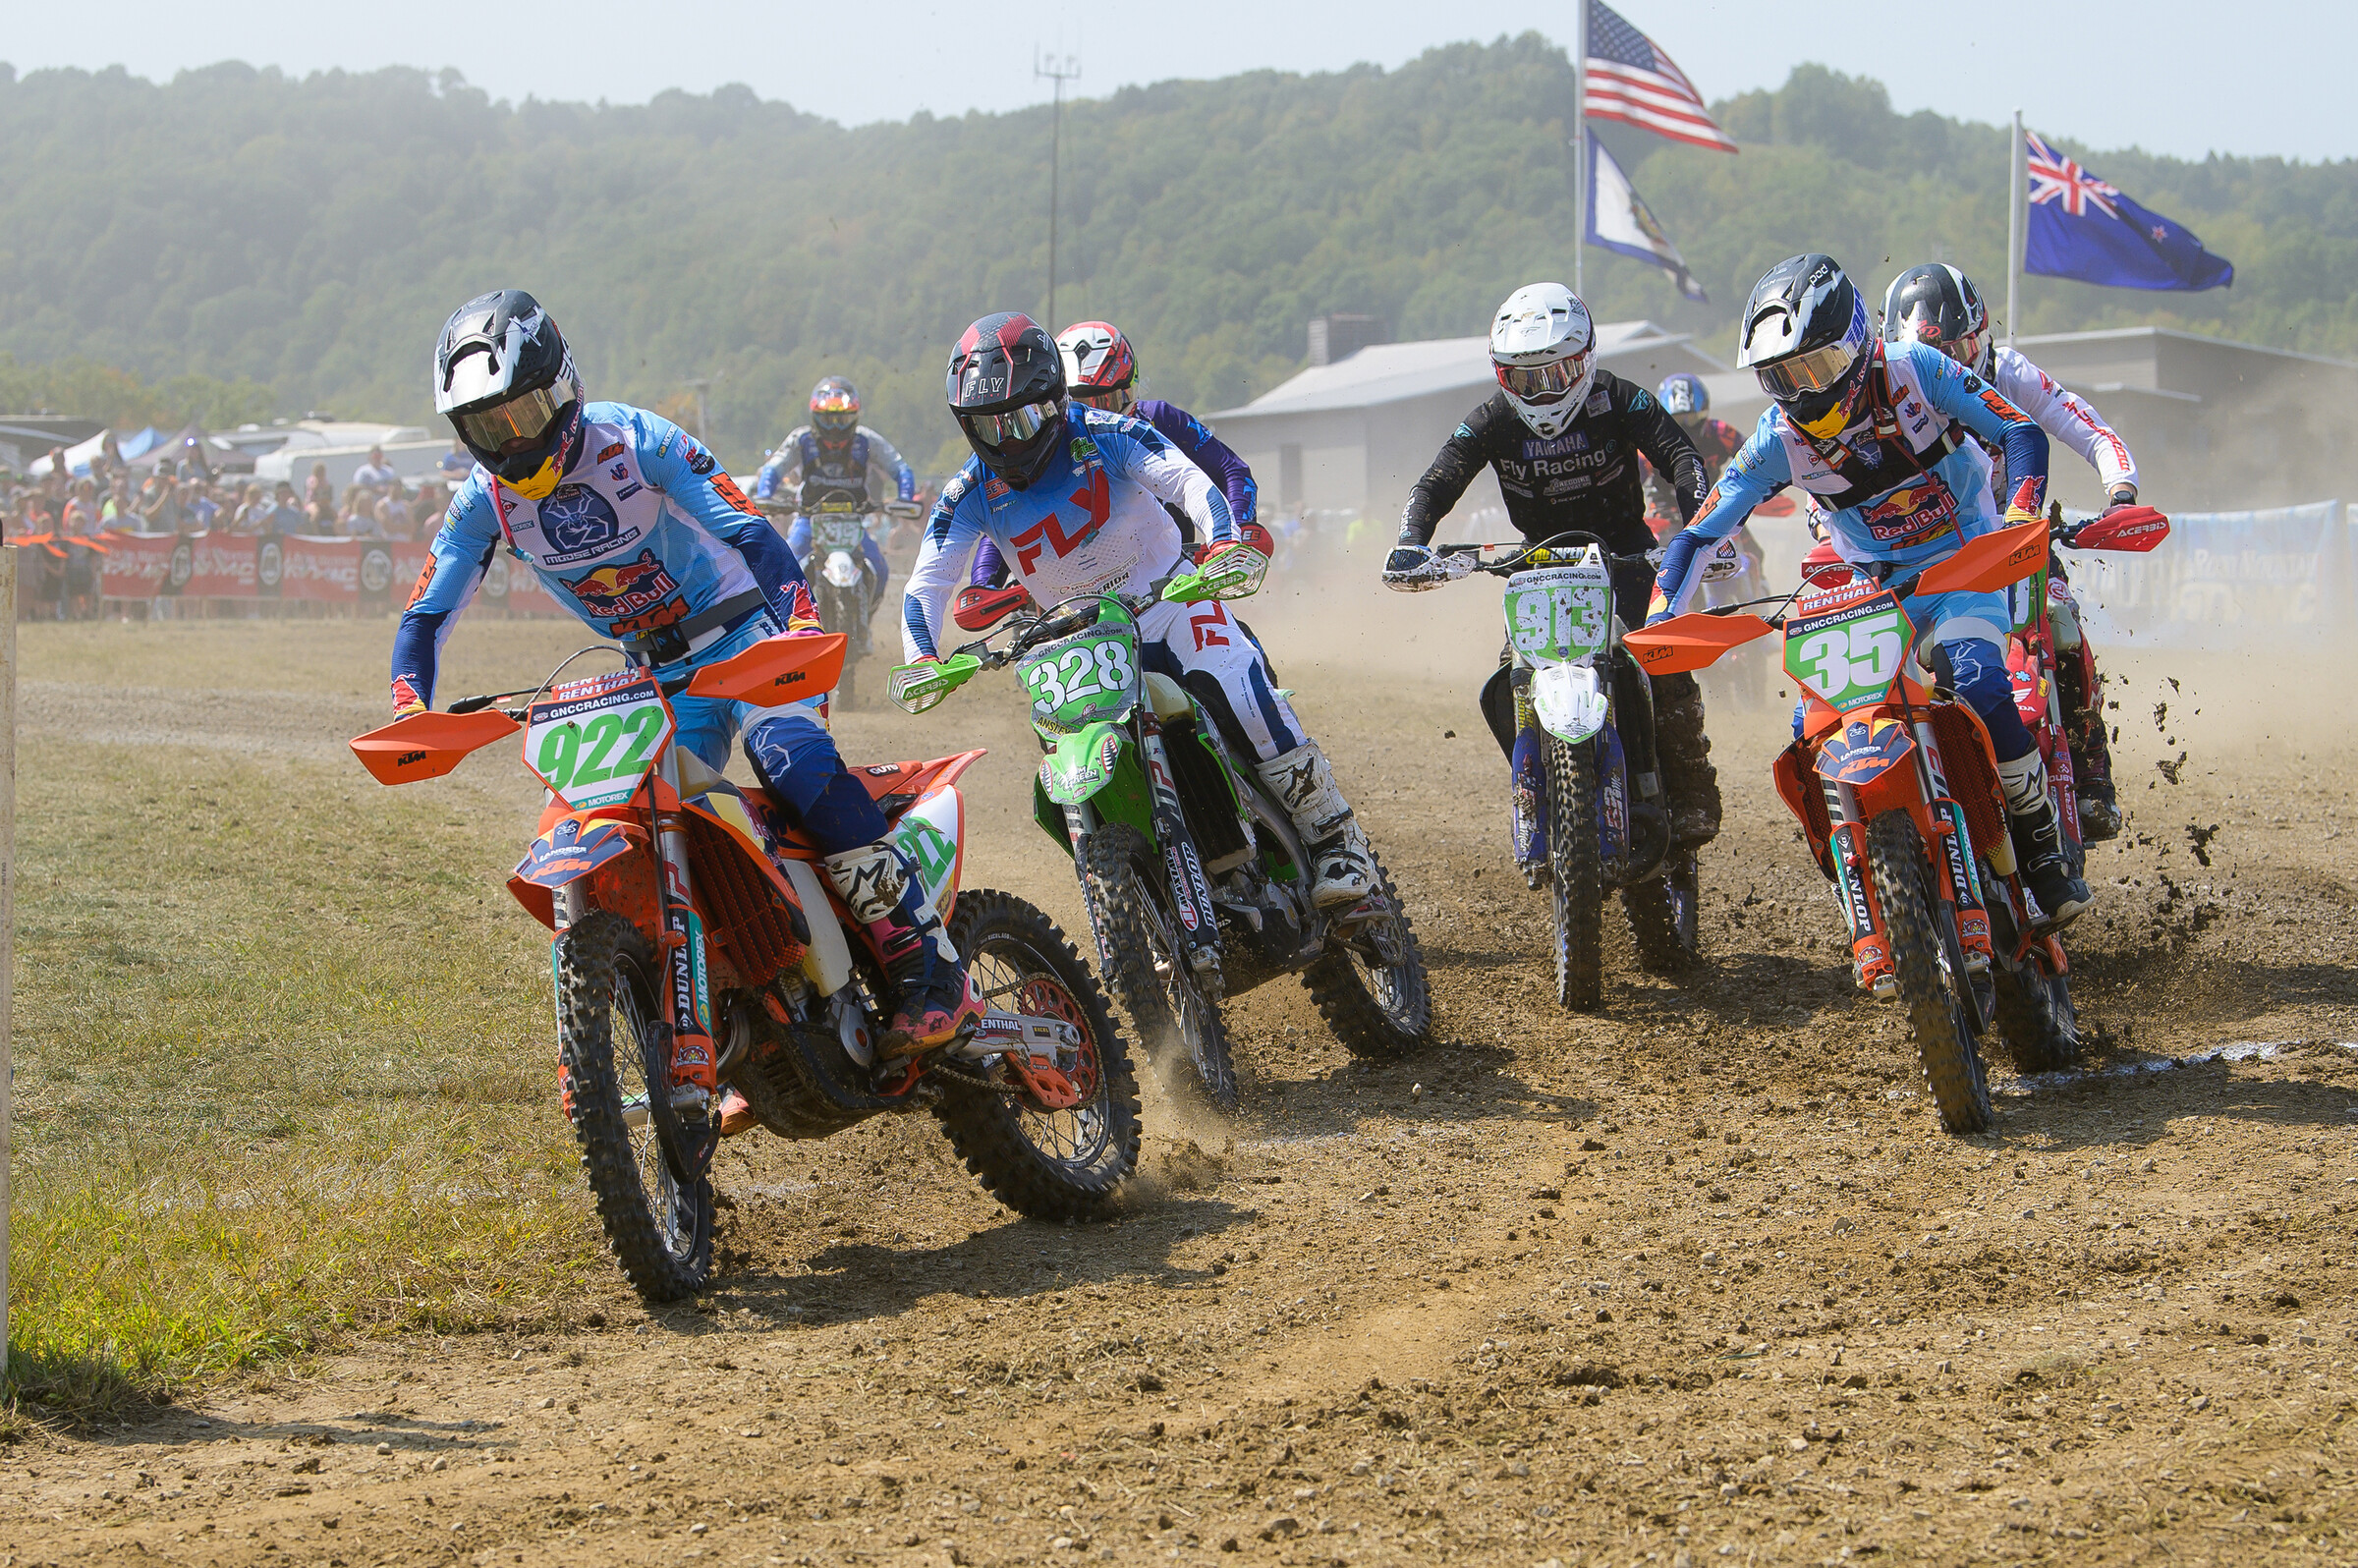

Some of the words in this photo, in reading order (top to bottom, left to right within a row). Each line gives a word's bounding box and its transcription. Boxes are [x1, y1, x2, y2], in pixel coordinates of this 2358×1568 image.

[965, 377, 1004, 398] FLY
[597, 442, 625, 465] KTM
[1526, 433, 1586, 458] YAMAHA
[1500, 458, 1527, 480] Fly
[1534, 449, 1606, 476] Racing
[1692, 458, 1706, 502] Racing
[1871, 517, 1918, 539] Red
[2116, 521, 2167, 538] ACERBIS
[546, 551, 590, 565] MOOSE
[591, 529, 639, 553] RACING
[2009, 545, 2042, 566] KTM
[582, 595, 632, 618] Red
[629, 573, 676, 610] Bull
[1198, 574, 1244, 594] ACERBIS
[1803, 587, 1875, 611] RENTHAL
[609, 595, 690, 638] KTM
[1516, 588, 1605, 650] 913
[1643, 645, 1673, 664] KTM
[1800, 613, 1902, 700] 35
[774, 671, 807, 687] KTM
[1028, 641, 1135, 714] 328
[905, 679, 949, 700] ACERBIS
[1848, 691, 1883, 706] MOTOREX
[397, 751, 426, 767] KTM
[537, 704, 665, 792] 922
[870, 763, 899, 775] GUTS
[1837, 756, 1890, 779] KTM
[589, 792, 629, 807] MOTOREX
[539, 846, 588, 863] LANDERS
[1940, 808, 1969, 889] DUNLP
[530, 859, 592, 880] KTM
[1181, 842, 1217, 931] DUNLOP
[672, 916, 691, 1011] DUNLP
[693, 929, 708, 1004] MOTOREX
[981, 1019, 1022, 1032] ENTHAL
